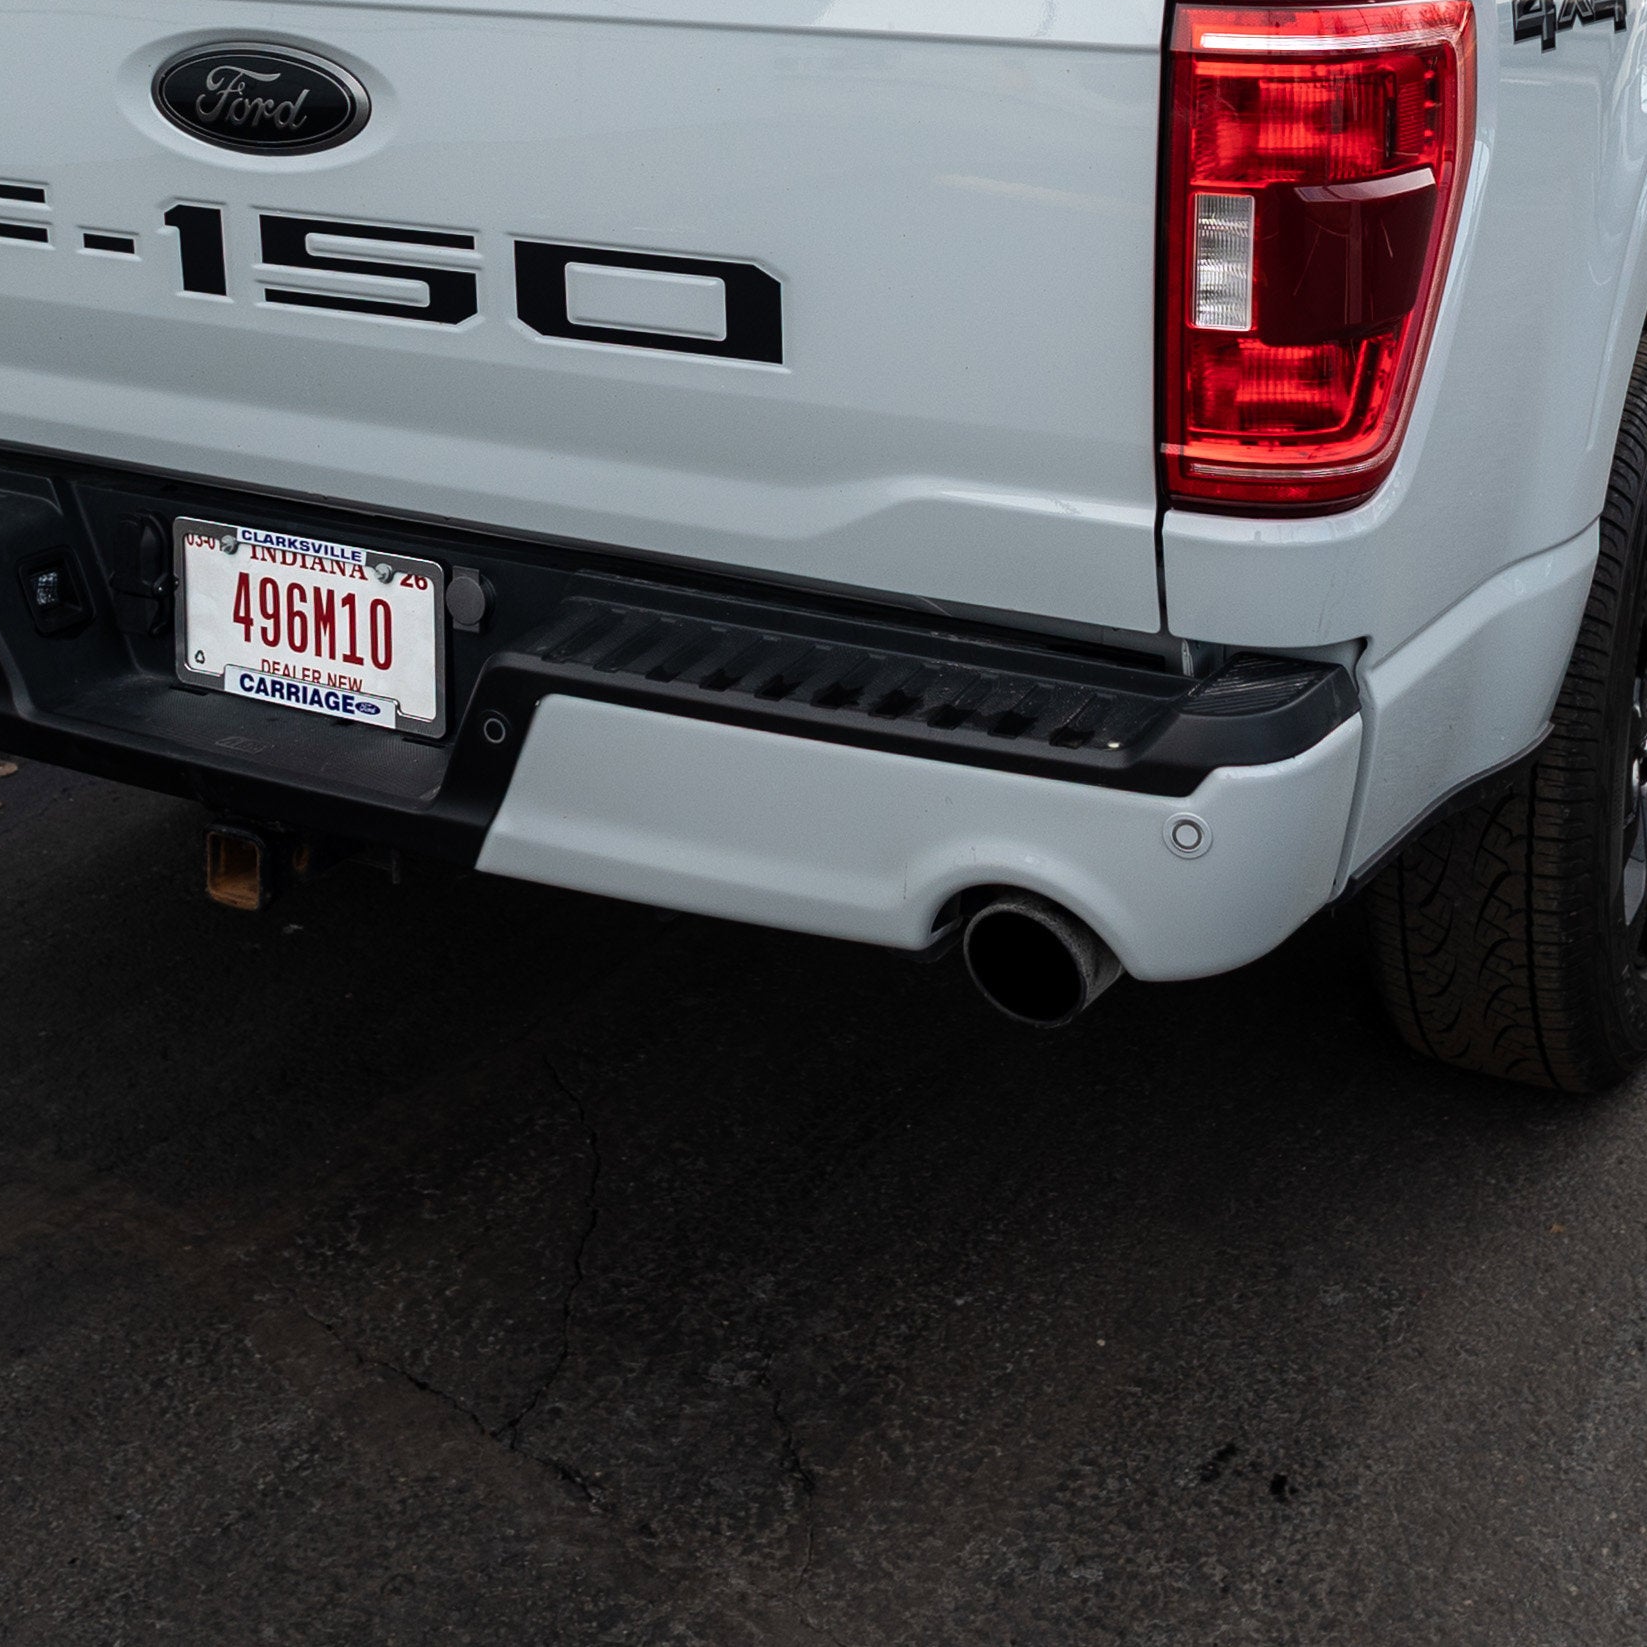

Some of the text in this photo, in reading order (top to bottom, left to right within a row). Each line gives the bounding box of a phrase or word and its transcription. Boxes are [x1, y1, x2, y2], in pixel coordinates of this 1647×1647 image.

[195, 65, 311, 131] Ford
[241, 530, 363, 563] CLARKSVILLE
[249, 544, 369, 581] INDIANA
[399, 574, 429, 591] 26
[233, 571, 393, 672] 496M10
[239, 672, 356, 715] CARRIAGE
[260, 658, 364, 693] DEALER NEW
